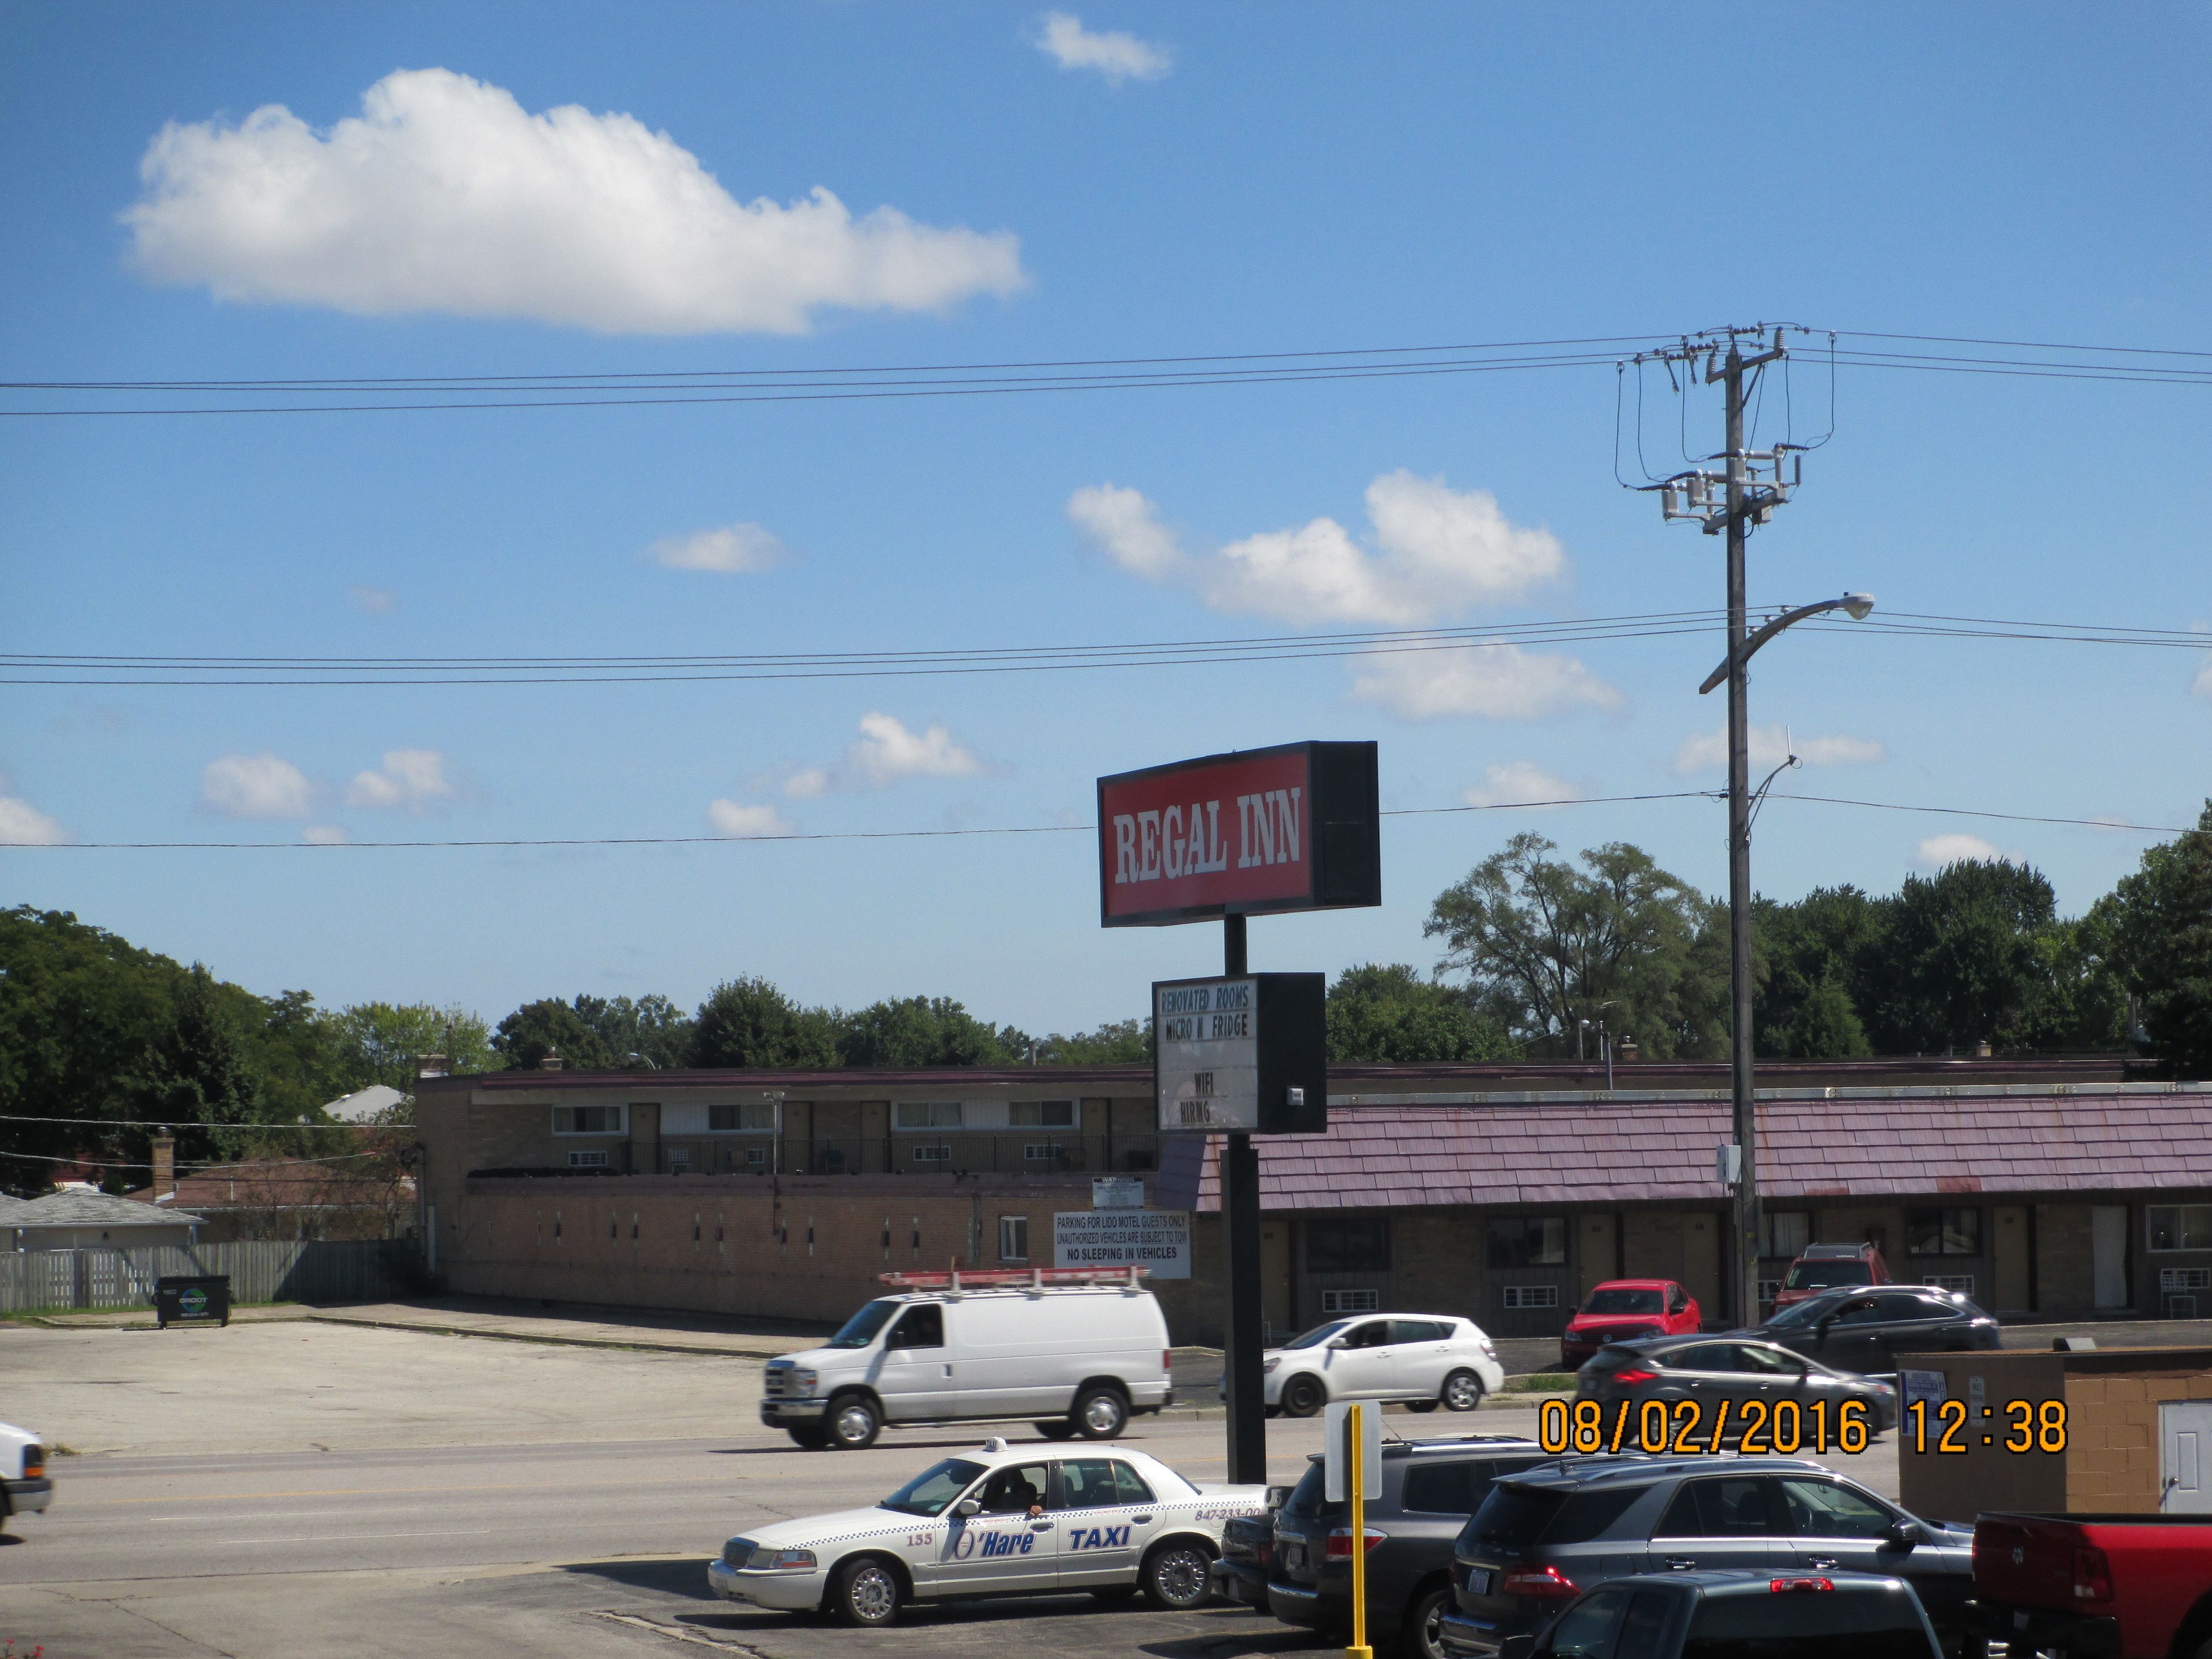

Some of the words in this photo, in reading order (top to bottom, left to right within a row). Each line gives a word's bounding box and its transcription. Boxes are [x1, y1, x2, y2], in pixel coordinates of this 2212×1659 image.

[1113, 800, 1227, 884] REGAL
[1237, 787, 1301, 868] INN
[1161, 988, 1209, 1013] RENOVATED
[1216, 985, 1249, 1008] ROOMS
[1166, 1017, 1192, 1040] MICRO
[1197, 1018, 1203, 1039] N
[1213, 1014, 1248, 1037] FRIDGE
[1194, 1072, 1214, 1094] WIFI
[1180, 1101, 1210, 1123] HIRING
[1057, 1217, 1086, 1229] PARKING
[1088, 1217, 1100, 1228] FOR
[1102, 1216, 1117, 1228] LIDO
[1119, 1215, 1140, 1228] MOTEL
[1142, 1215, 1168, 1228] GUESTS
[1168, 1215, 1185, 1228] ONLY
[1056, 1232, 1099, 1244] UNAUTHORIZED
[1100, 1232, 1127, 1244] VEHICLES
[1127, 1232, 1139, 1243] ARE
[1141, 1231, 1165, 1243] SUBJECT
[1166, 1231, 1174, 1243] TO
[1175, 1230, 1187, 1243] TOW
[1067, 1249, 1080, 1260] NO
[1082, 1248, 1122, 1260] SLEEPING
[1126, 1248, 1134, 1259] IN
[1137, 1247, 1177, 1259] VEHICLES
[986, 1439, 997, 1450] TAXI
[953, 1530, 1035, 1560] O'Hare
[1068, 1524, 1132, 1551] TAXI
